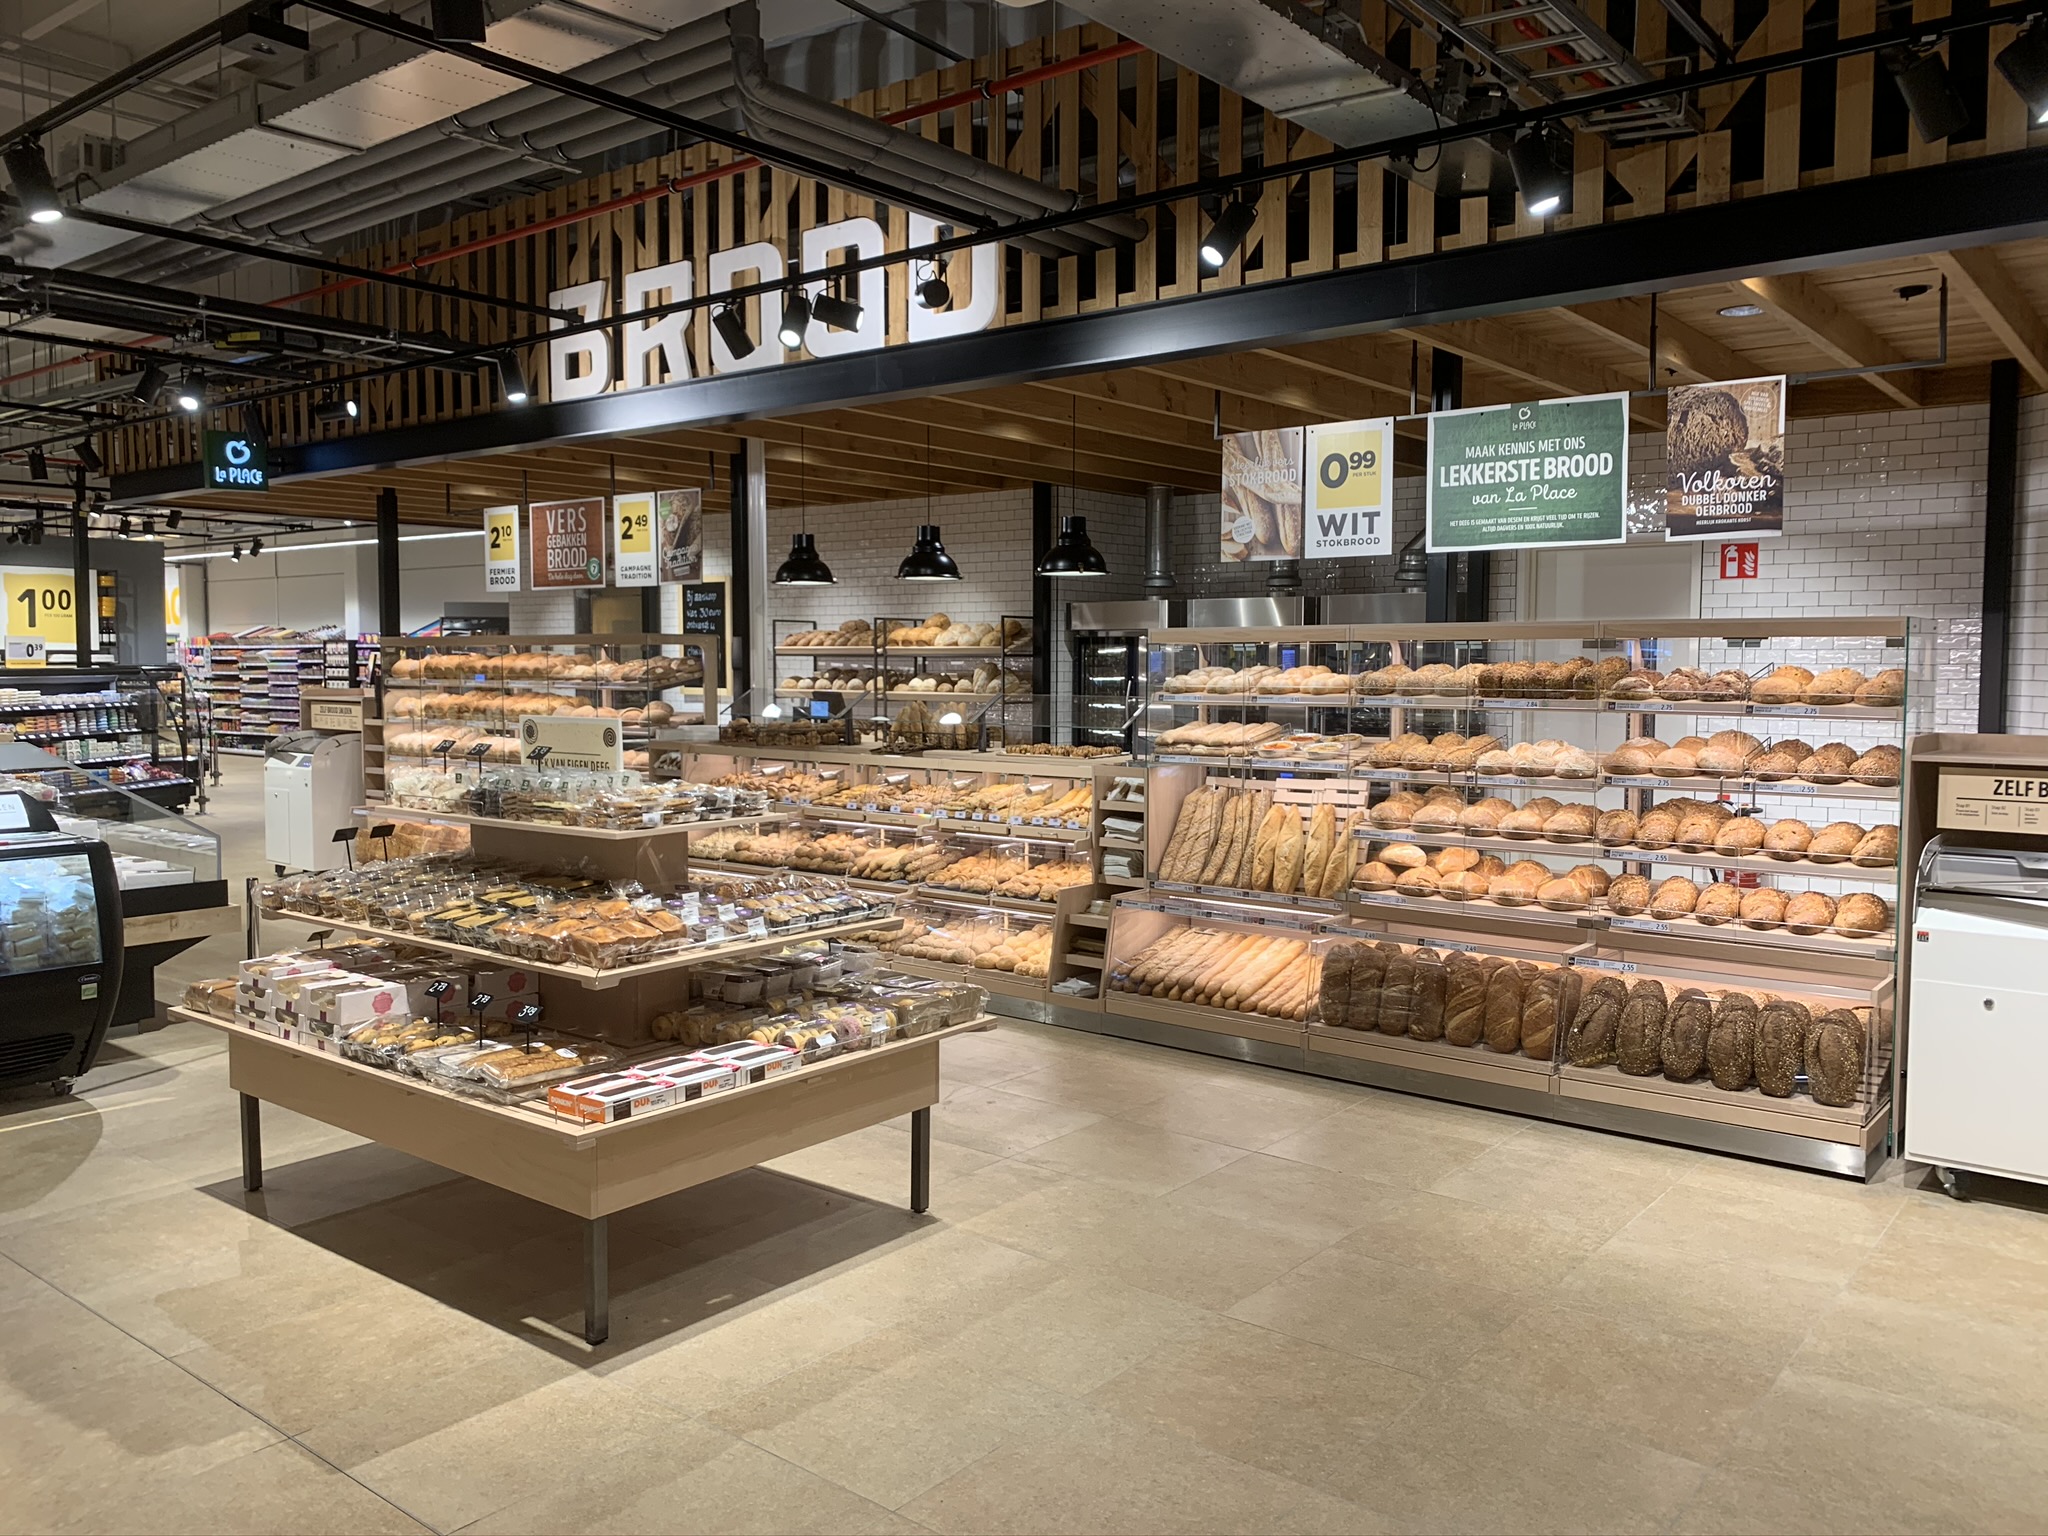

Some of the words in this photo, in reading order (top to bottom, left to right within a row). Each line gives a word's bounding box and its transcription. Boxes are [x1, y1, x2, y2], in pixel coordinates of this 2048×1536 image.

[549, 210, 1000, 402] BROOD
[1465, 444, 1496, 459] MAAK
[1498, 441, 1536, 456] KENNIS
[1538, 438, 1561, 453] MET
[1563, 436, 1586, 449] ONS
[229, 467, 263, 485] PLACE
[1229, 468, 1297, 488] STOKBROOD
[1440, 458, 1540, 488] LEKKERSTE
[1544, 452, 1614, 480] BROOD
[1677, 470, 1776, 493] Volkoren
[1472, 492, 1502, 505] van
[1505, 486, 1527, 503] La
[1531, 484, 1578, 501] Place
[1696, 503, 1753, 517] OERBROOD
[546, 507, 587, 534] VERS
[1317, 511, 1381, 537] WIT
[547, 533, 587, 548] GEBAKKEN
[1316, 537, 1381, 548] STOKBROOD
[547, 548, 588, 569] BROOD
[620, 564, 652, 572] CAMPAGNE
[489, 568, 516, 576] FERMIER
[490, 576, 516, 585] BROOD
[1993, 779, 2034, 797] ZELF
